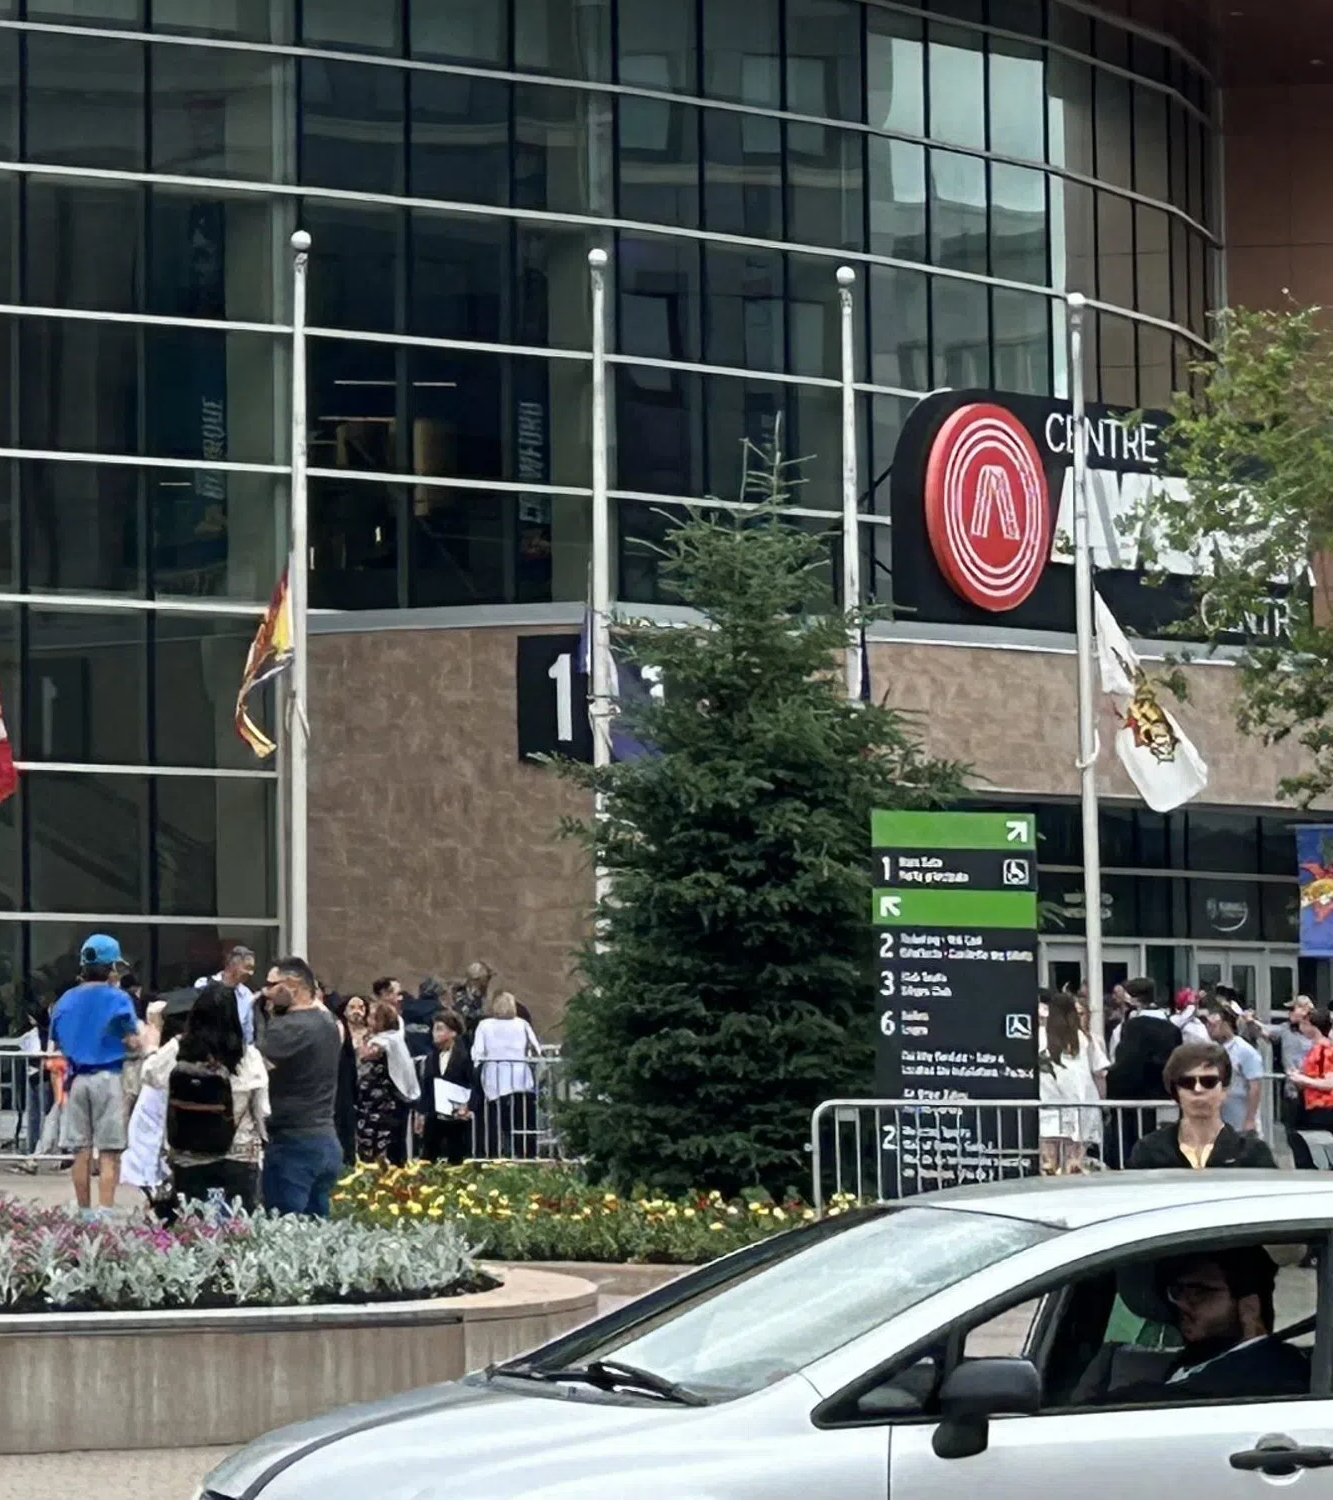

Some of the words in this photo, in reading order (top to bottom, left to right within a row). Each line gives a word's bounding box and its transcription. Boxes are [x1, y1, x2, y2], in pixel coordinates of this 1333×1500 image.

[547, 653, 573, 741] 1
[882, 856, 891, 881] 1
[879, 932, 894, 958] 2
[879, 971, 895, 996] 3
[880, 1010, 896, 1036] 6
[882, 1125, 898, 1150] 2
